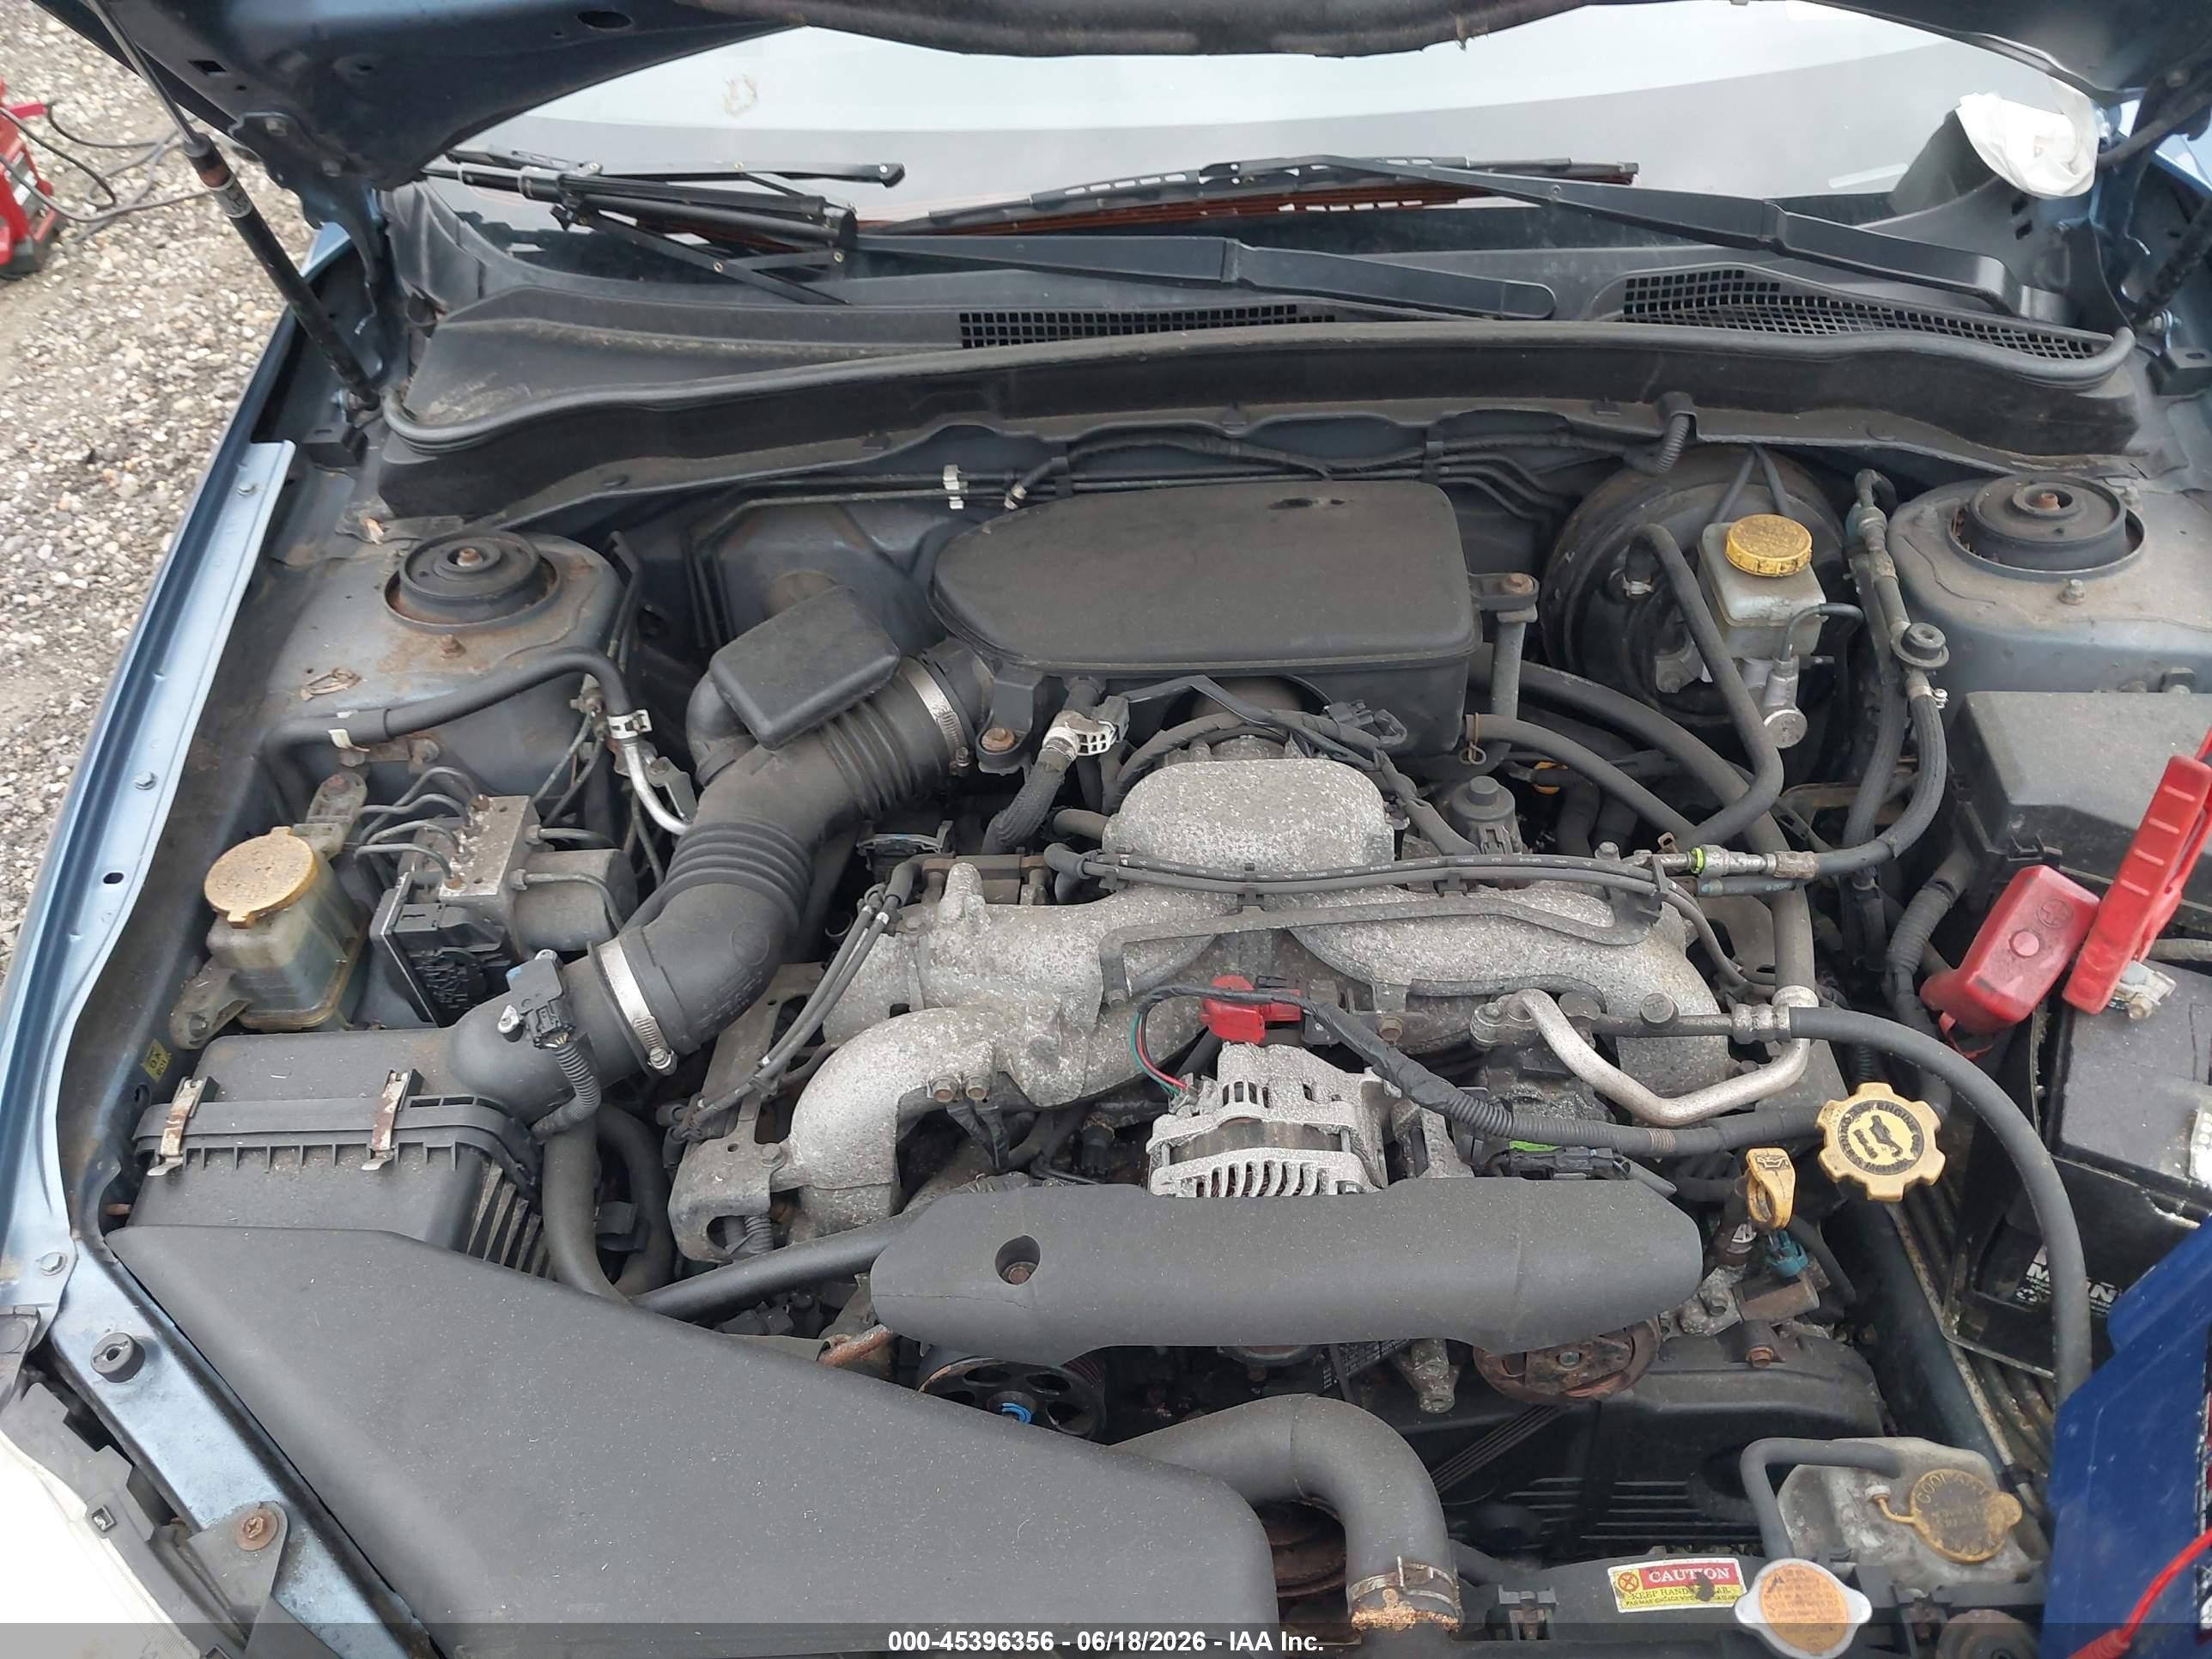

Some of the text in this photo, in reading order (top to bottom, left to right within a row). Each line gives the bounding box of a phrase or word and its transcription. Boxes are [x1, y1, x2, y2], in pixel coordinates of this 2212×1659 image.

[1649, 1566, 1730, 1583] CAUTON
[1631, 1586, 1694, 1600] KEEP HAND
